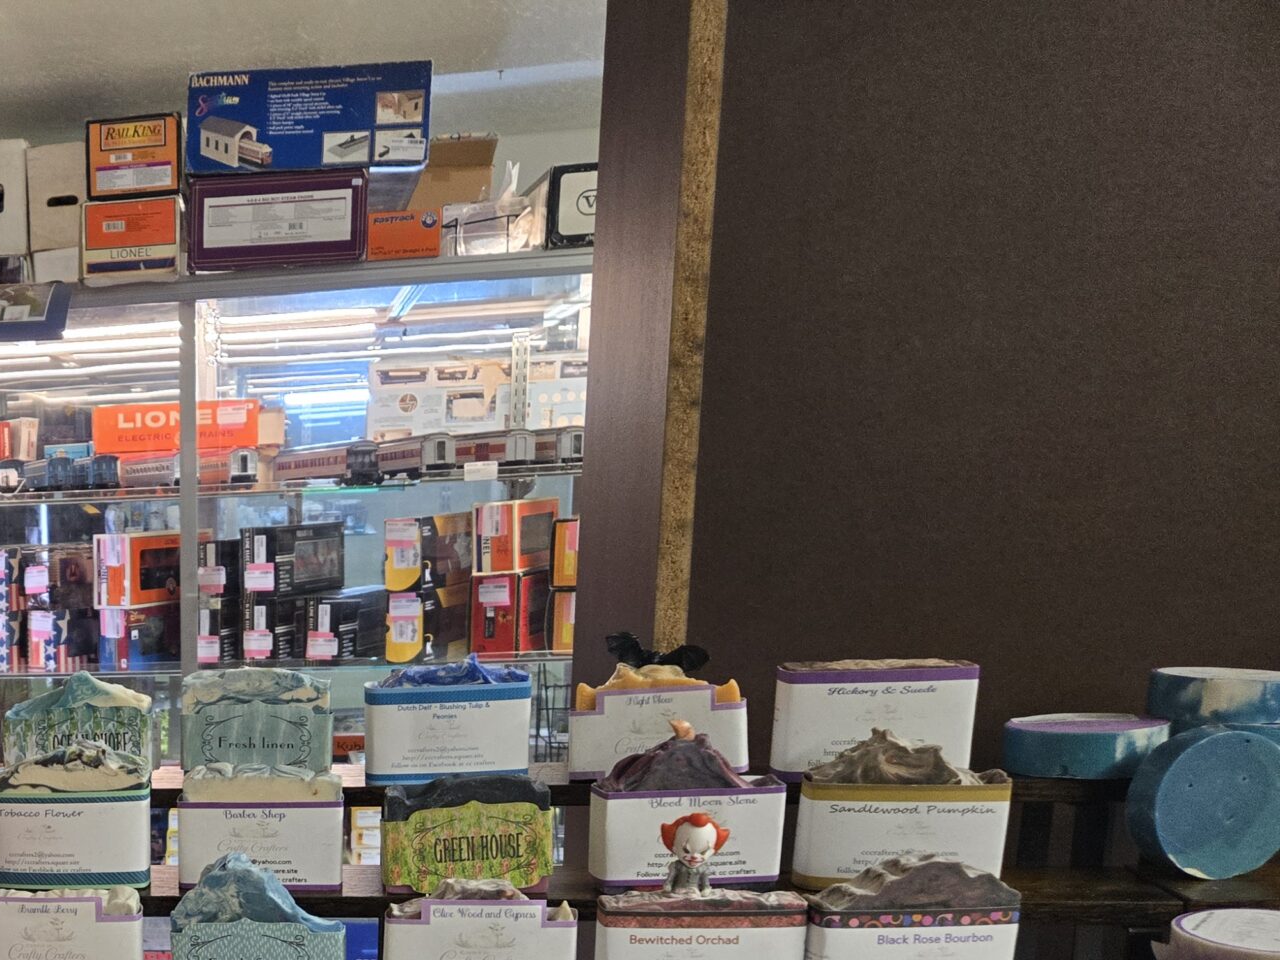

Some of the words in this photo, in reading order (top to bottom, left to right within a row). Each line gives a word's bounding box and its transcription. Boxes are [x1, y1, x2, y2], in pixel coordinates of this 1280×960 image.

[191, 74, 249, 88] BACHMANN
[110, 247, 151, 260] LIONEL
[118, 433, 171, 443] ELECTRIC
[199, 430, 234, 439] RAINS
[900, 684, 938, 695] Suede
[439, 703, 467, 712] Blushing
[468, 702, 484, 711] Tulip
[218, 736, 256, 750] Fresh
[261, 736, 294, 750] linen
[648, 797, 682, 809] Blood
[688, 797, 723, 808] Moon
[726, 796, 759, 807] Stone
[44, 808, 84, 818] Flower
[223, 810, 257, 820] Barber
[261, 809, 286, 822] Shop
[829, 804, 921, 815] Sandlewood
[926, 804, 998, 816] Pumpkin
[433, 836, 475, 864] GREEN
[480, 832, 524, 860] HOUSE
[728, 867, 756, 876] crafters
[484, 907, 501, 919] and
[629, 934, 693, 946] Bewitched
[695, 934, 740, 946] Orchad
[877, 934, 910, 945] Black
[913, 933, 941, 944] Rose
[944, 932, 994, 944] Bourbon
